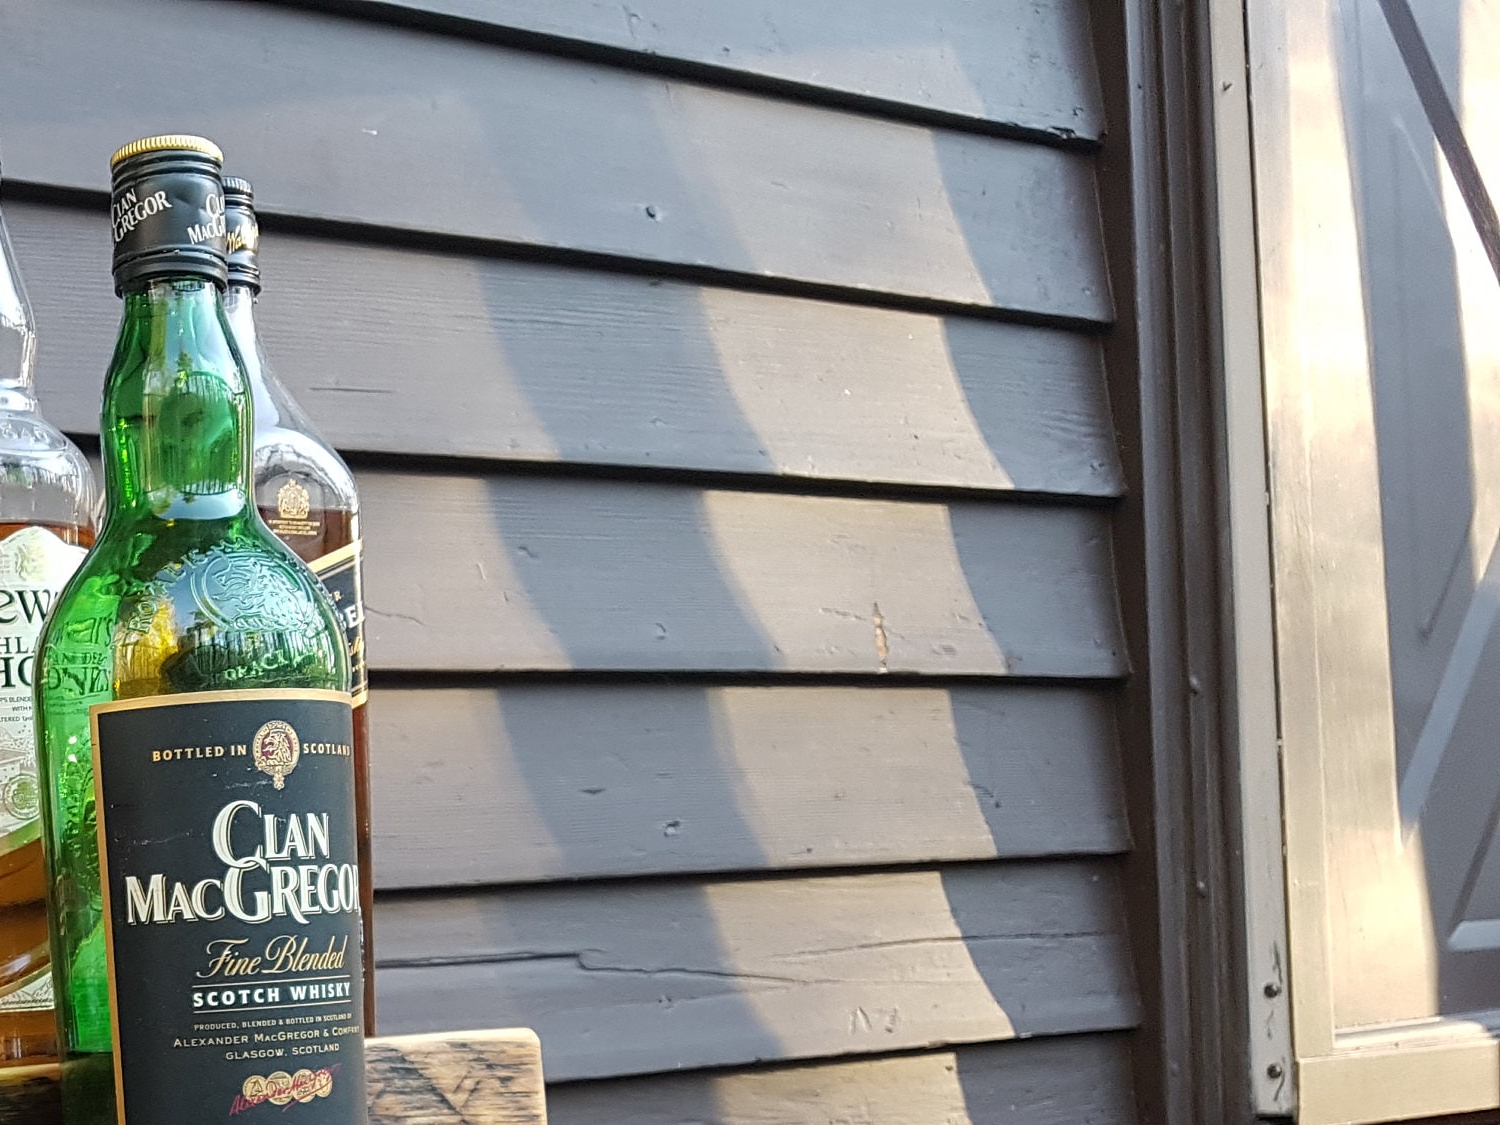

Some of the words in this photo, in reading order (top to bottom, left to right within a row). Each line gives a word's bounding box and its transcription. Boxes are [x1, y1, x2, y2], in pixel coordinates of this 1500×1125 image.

[114, 190, 173, 242] GREGOR
[152, 745, 225, 762] BOTTLED
[230, 744, 247, 756] IN
[303, 742, 351, 757] SCOTLAND
[212, 799, 330, 869] CLAN
[196, 937, 262, 978] Fine
[261, 934, 349, 974] Blended
[193, 987, 280, 1008] SCOTCH
[290, 981, 351, 1001] WHISKY
[242, 1019, 277, 1029] BLENDED
[285, 1016, 314, 1025] BOTTLED
[173, 1034, 249, 1048] ALEXANDER
[323, 1029, 330, 1037] &
[291, 1042, 340, 1056] SCOTLAND
